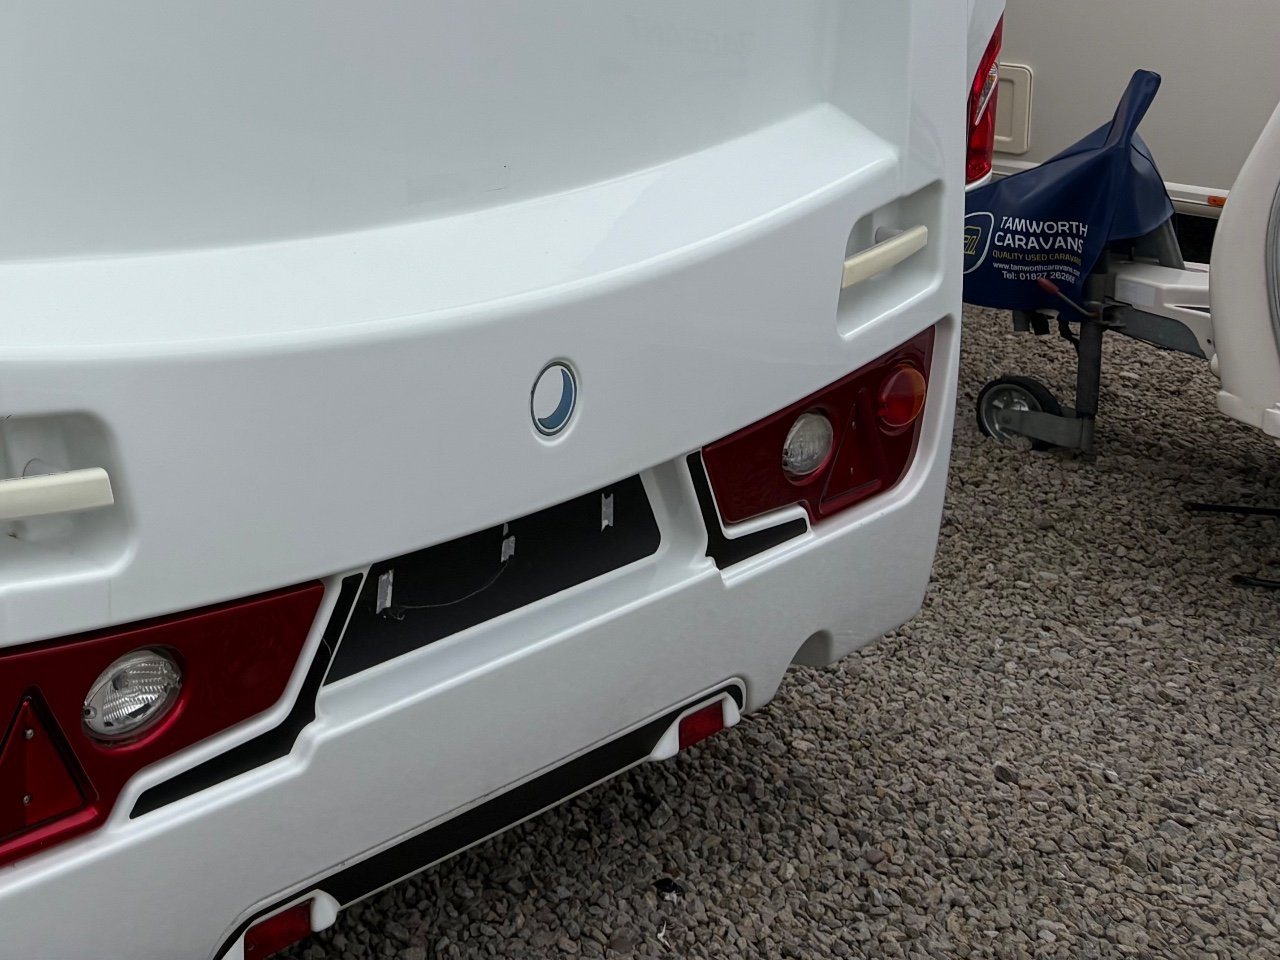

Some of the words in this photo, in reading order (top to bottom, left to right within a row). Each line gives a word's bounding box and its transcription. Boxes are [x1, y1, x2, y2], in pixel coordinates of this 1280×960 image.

[1000, 216, 1089, 237] TAMWORTH
[994, 231, 1084, 254] CARAVANS
[992, 249, 1022, 260] QUALITY
[1025, 253, 1048, 261] USED
[1002, 270, 1017, 280] Tel:
[1019, 272, 1047, 280] 01827
